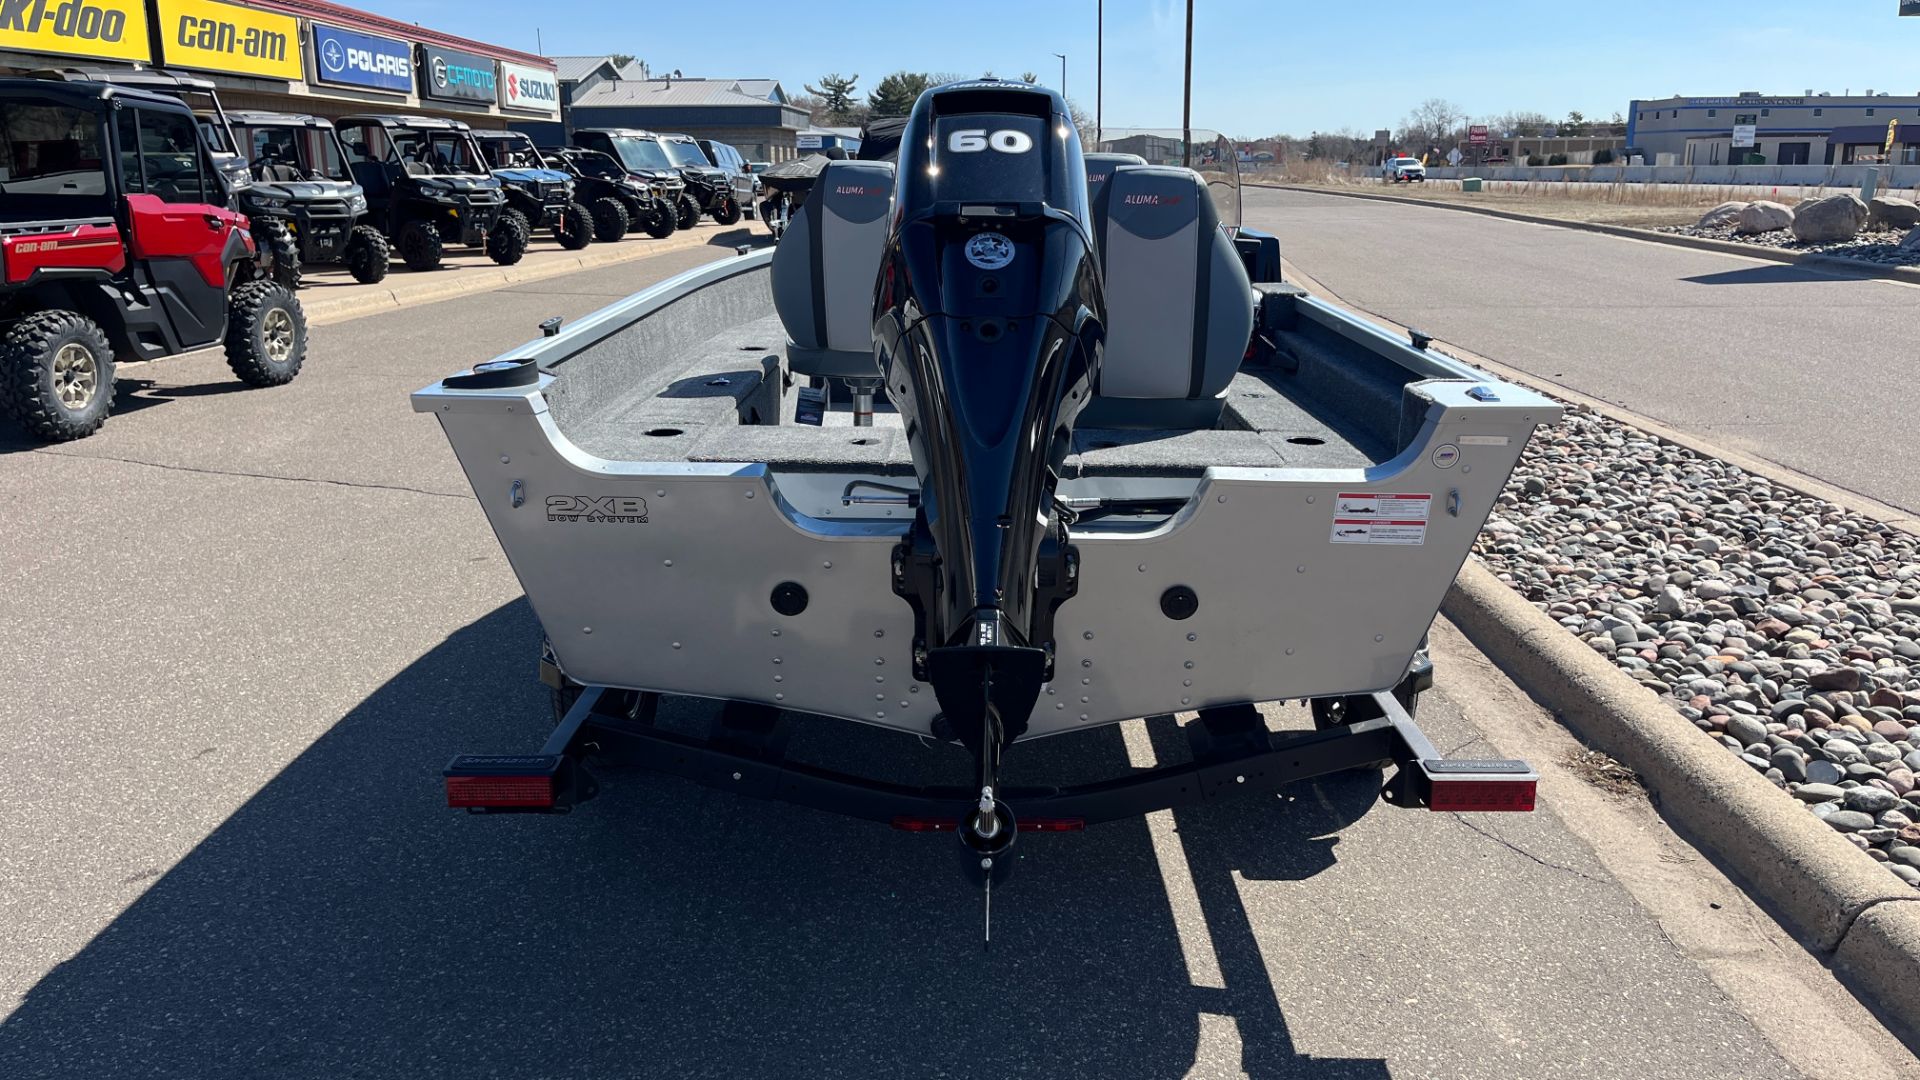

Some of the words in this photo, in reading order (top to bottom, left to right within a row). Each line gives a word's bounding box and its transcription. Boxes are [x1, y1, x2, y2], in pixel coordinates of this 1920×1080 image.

[0, 0, 126, 42] ki-doo
[178, 15, 287, 61] can-am
[347, 48, 409, 77] POLARIS
[447, 64, 494, 90] CFMOTO
[520, 78, 555, 101] SUZUKI
[948, 129, 1033, 154] 60
[15, 241, 59, 253] can-am
[546, 495, 648, 517] 2XB
[587, 515, 648, 523] SYSTEM
